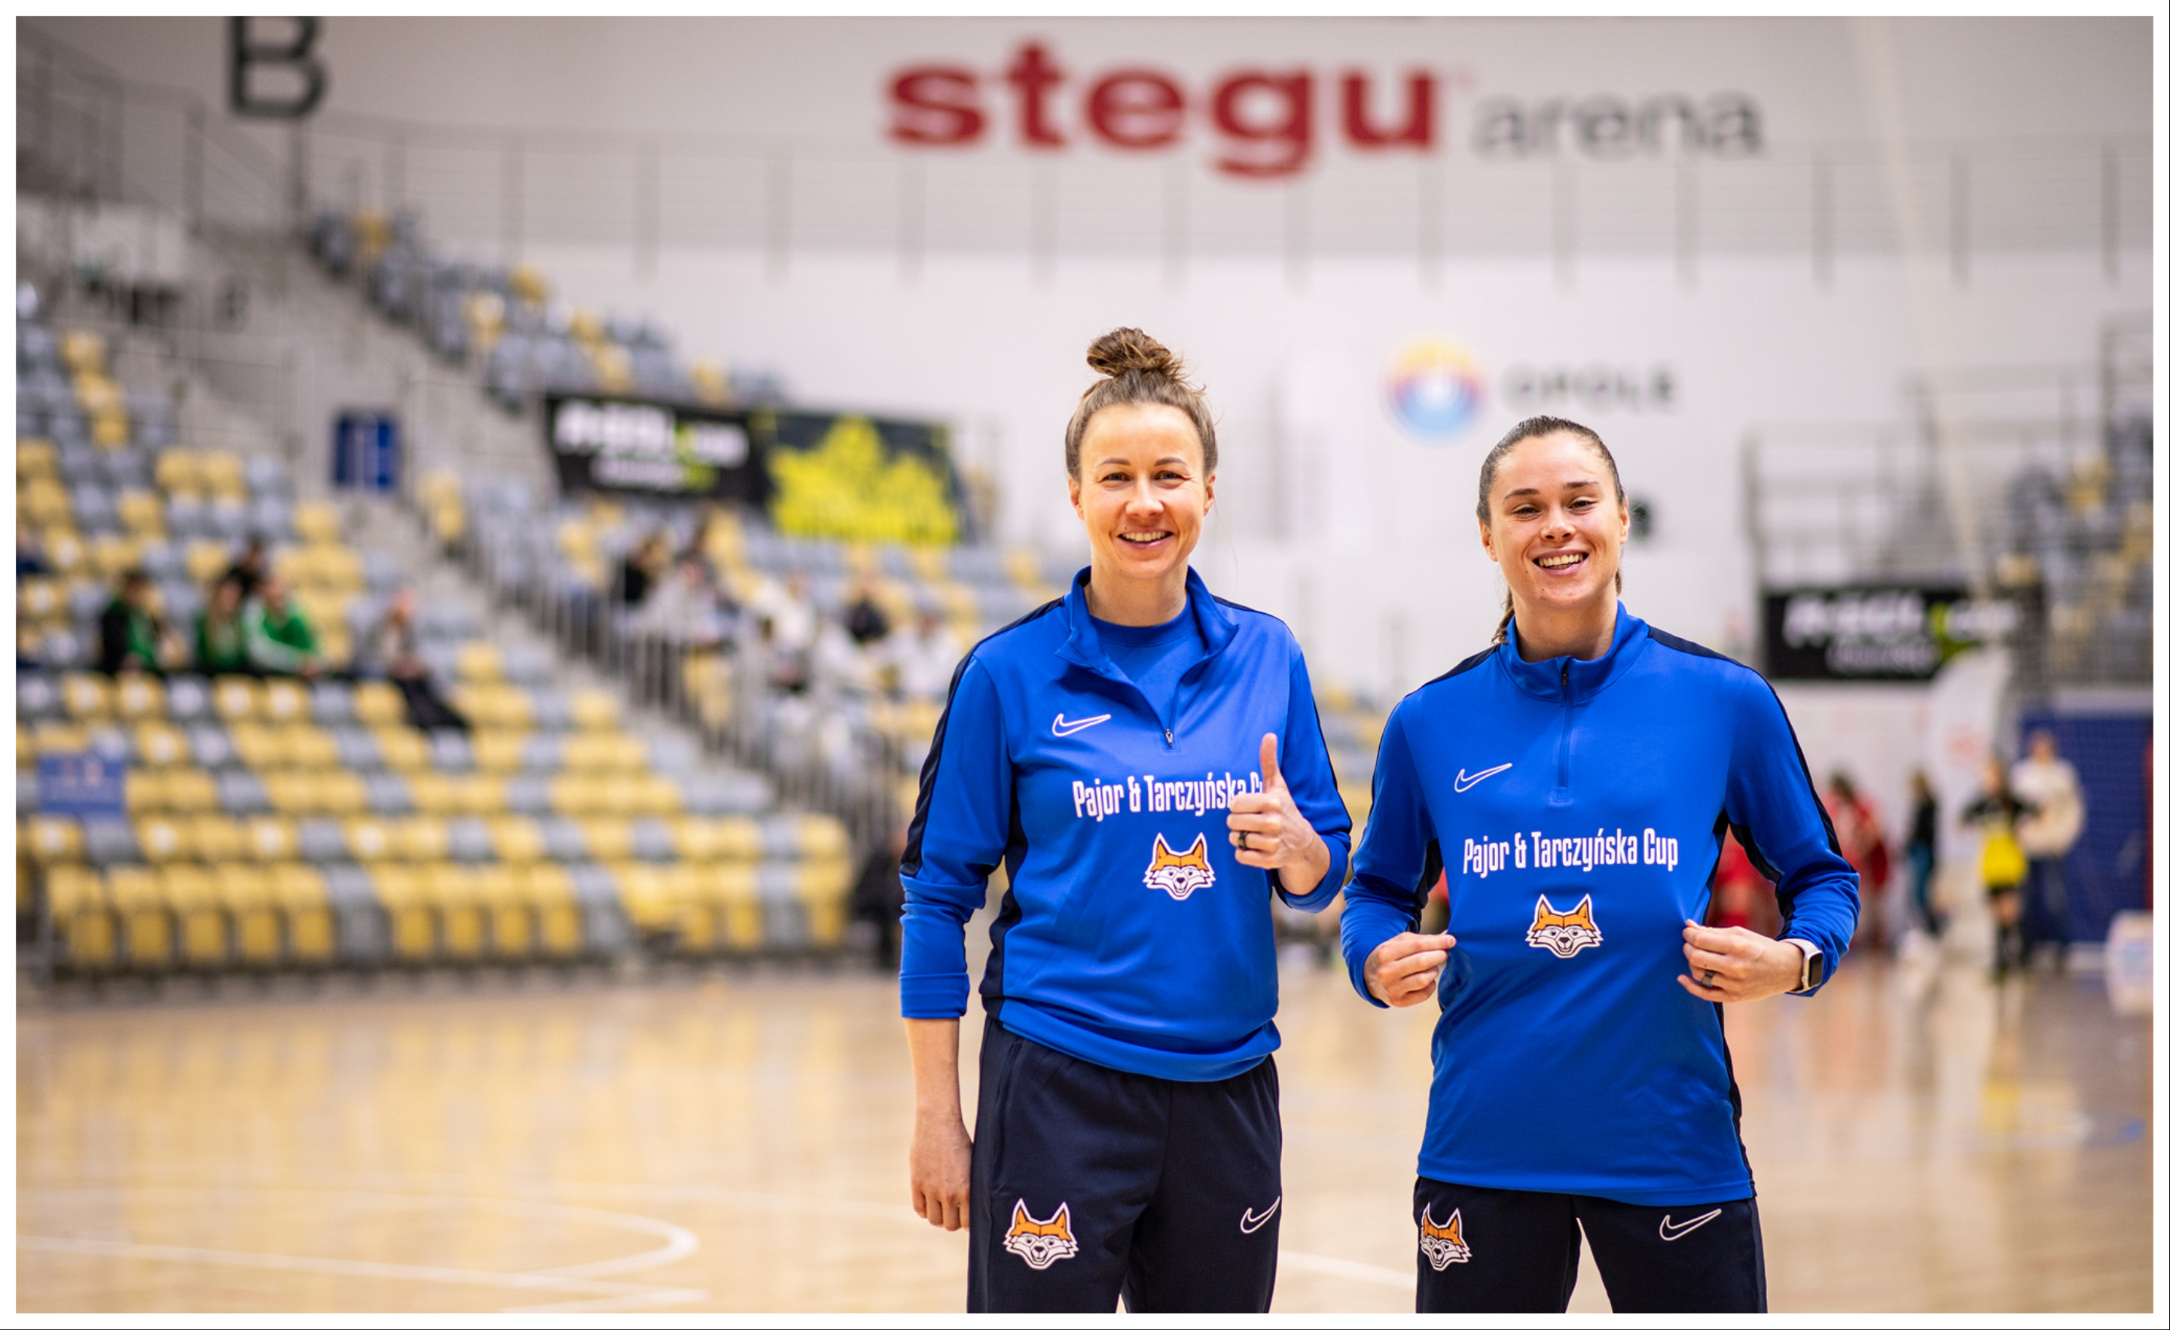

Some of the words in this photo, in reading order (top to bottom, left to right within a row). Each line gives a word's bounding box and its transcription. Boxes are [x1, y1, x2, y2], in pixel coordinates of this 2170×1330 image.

[227, 17, 327, 122] B
[886, 42, 1439, 180] stegu
[1476, 92, 1767, 158] arena
[1072, 777, 1125, 822] Pajor
[1128, 775, 1142, 813] &
[1463, 836, 1510, 879] Pajor
[1514, 832, 1527, 869] &
[1531, 827, 1638, 873] Tarczyńska
[1643, 827, 1679, 872] Cup
